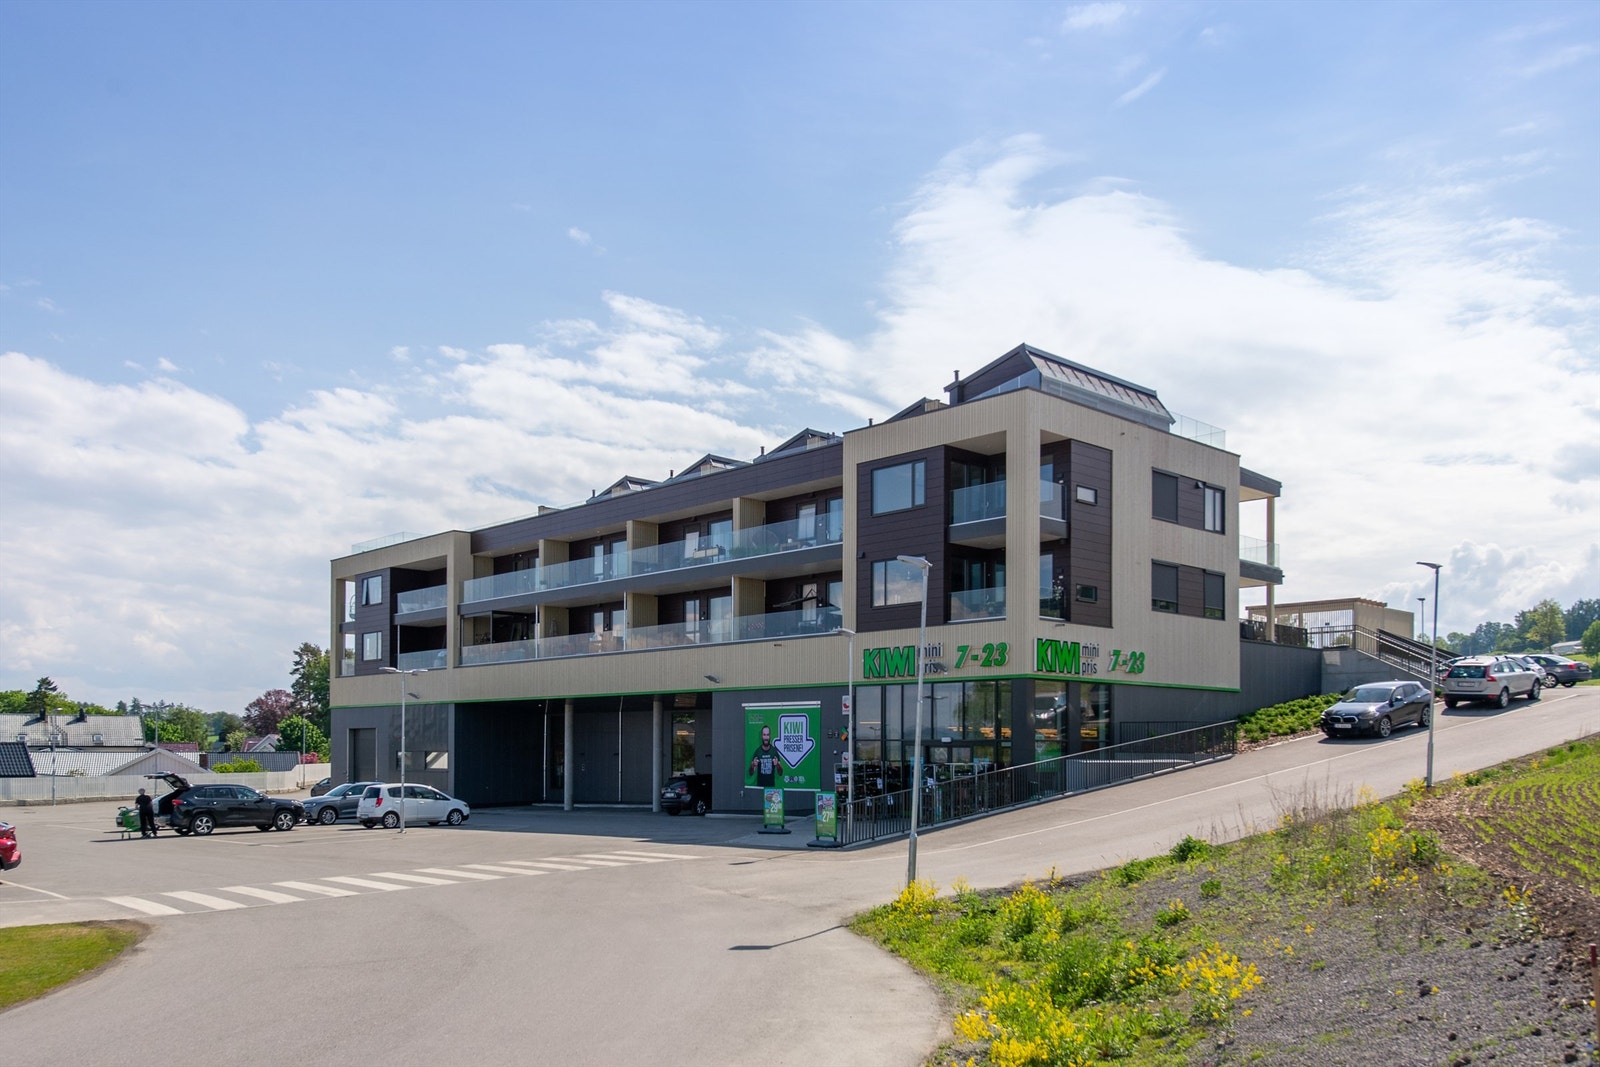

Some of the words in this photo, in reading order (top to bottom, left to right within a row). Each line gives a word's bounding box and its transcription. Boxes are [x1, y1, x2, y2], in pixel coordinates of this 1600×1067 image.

[1034, 638, 1080, 674] KIWI
[1082, 643, 1099, 657] mini
[863, 645, 915, 678] KIWI
[917, 659, 938, 676] ris
[1082, 659, 1098, 675] pris
[783, 721, 804, 734] KIWI
[783, 735, 804, 743] PRESSER
